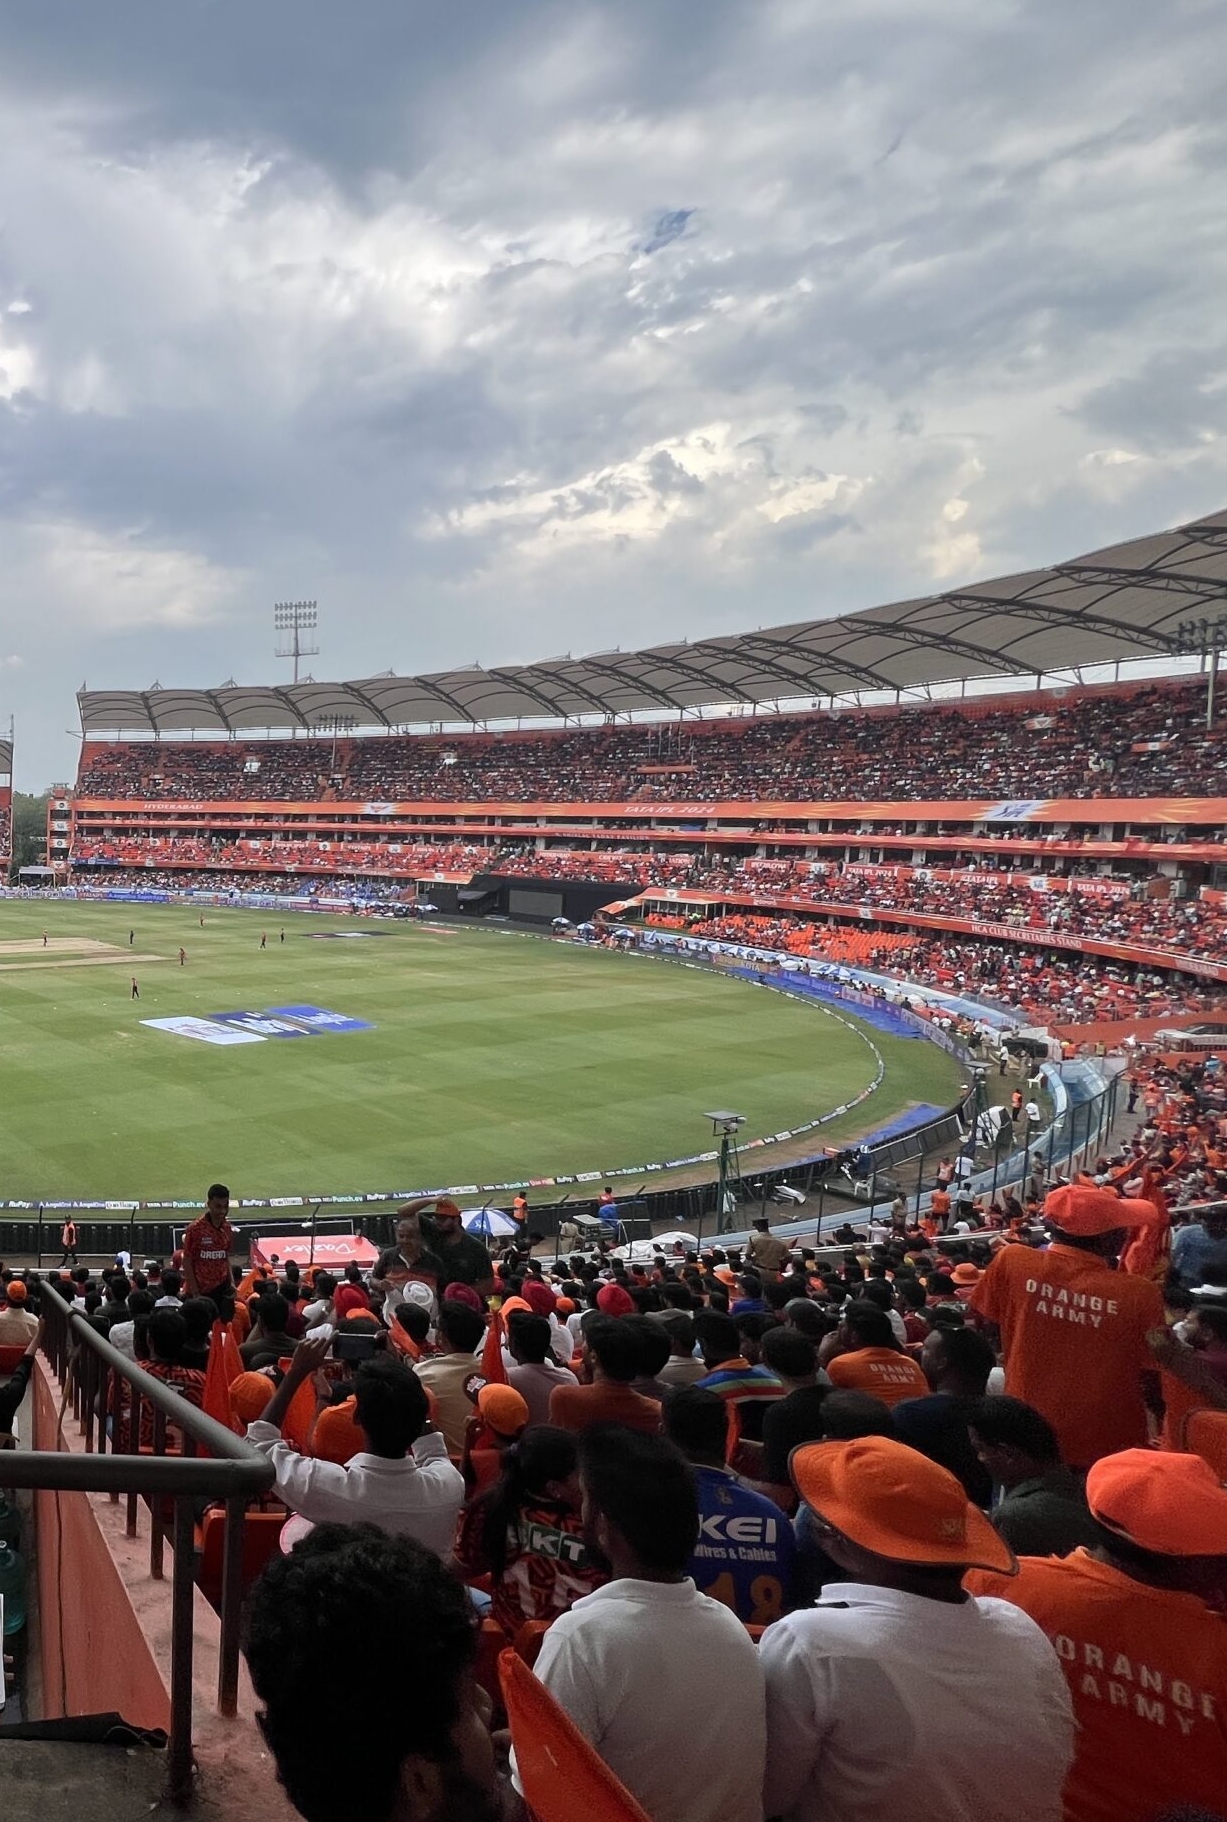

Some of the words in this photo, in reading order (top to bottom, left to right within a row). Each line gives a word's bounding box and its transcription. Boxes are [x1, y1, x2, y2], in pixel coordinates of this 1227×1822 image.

[655, 806, 676, 814] IPL
[678, 806, 716, 814] 2024
[848, 867, 864, 875] TATA
[1077, 883, 1095, 891] TATA
[1110, 886, 1130, 895] 2024
[972, 925, 988, 934] HCA
[990, 926, 1008, 936] CLUB
[1009, 929, 1056, 944] SECRETARIES
[1058, 937, 1082, 948] STAND
[504, 1181, 530, 1190] Punch.ev
[332, 1194, 363, 1203] Punch.ev
[367, 1193, 386, 1201] RuPay
[9, 1200, 31, 1208] RuPay
[173, 1201, 205, 1209] Punch.ev
[242, 1199, 263, 1208] RuPay
[1026, 1278, 1119, 1316] ORANGE
[1036, 1301, 1103, 1329] ARMY
[869, 1363, 915, 1375] ORANGE
[698, 1513, 777, 1544] KEI
[729, 1549, 737, 1560] &
[738, 1546, 777, 1562] Cables
[1055, 1634, 1217, 1721] ORANGE
[1080, 1673, 1196, 1735] ARMY
